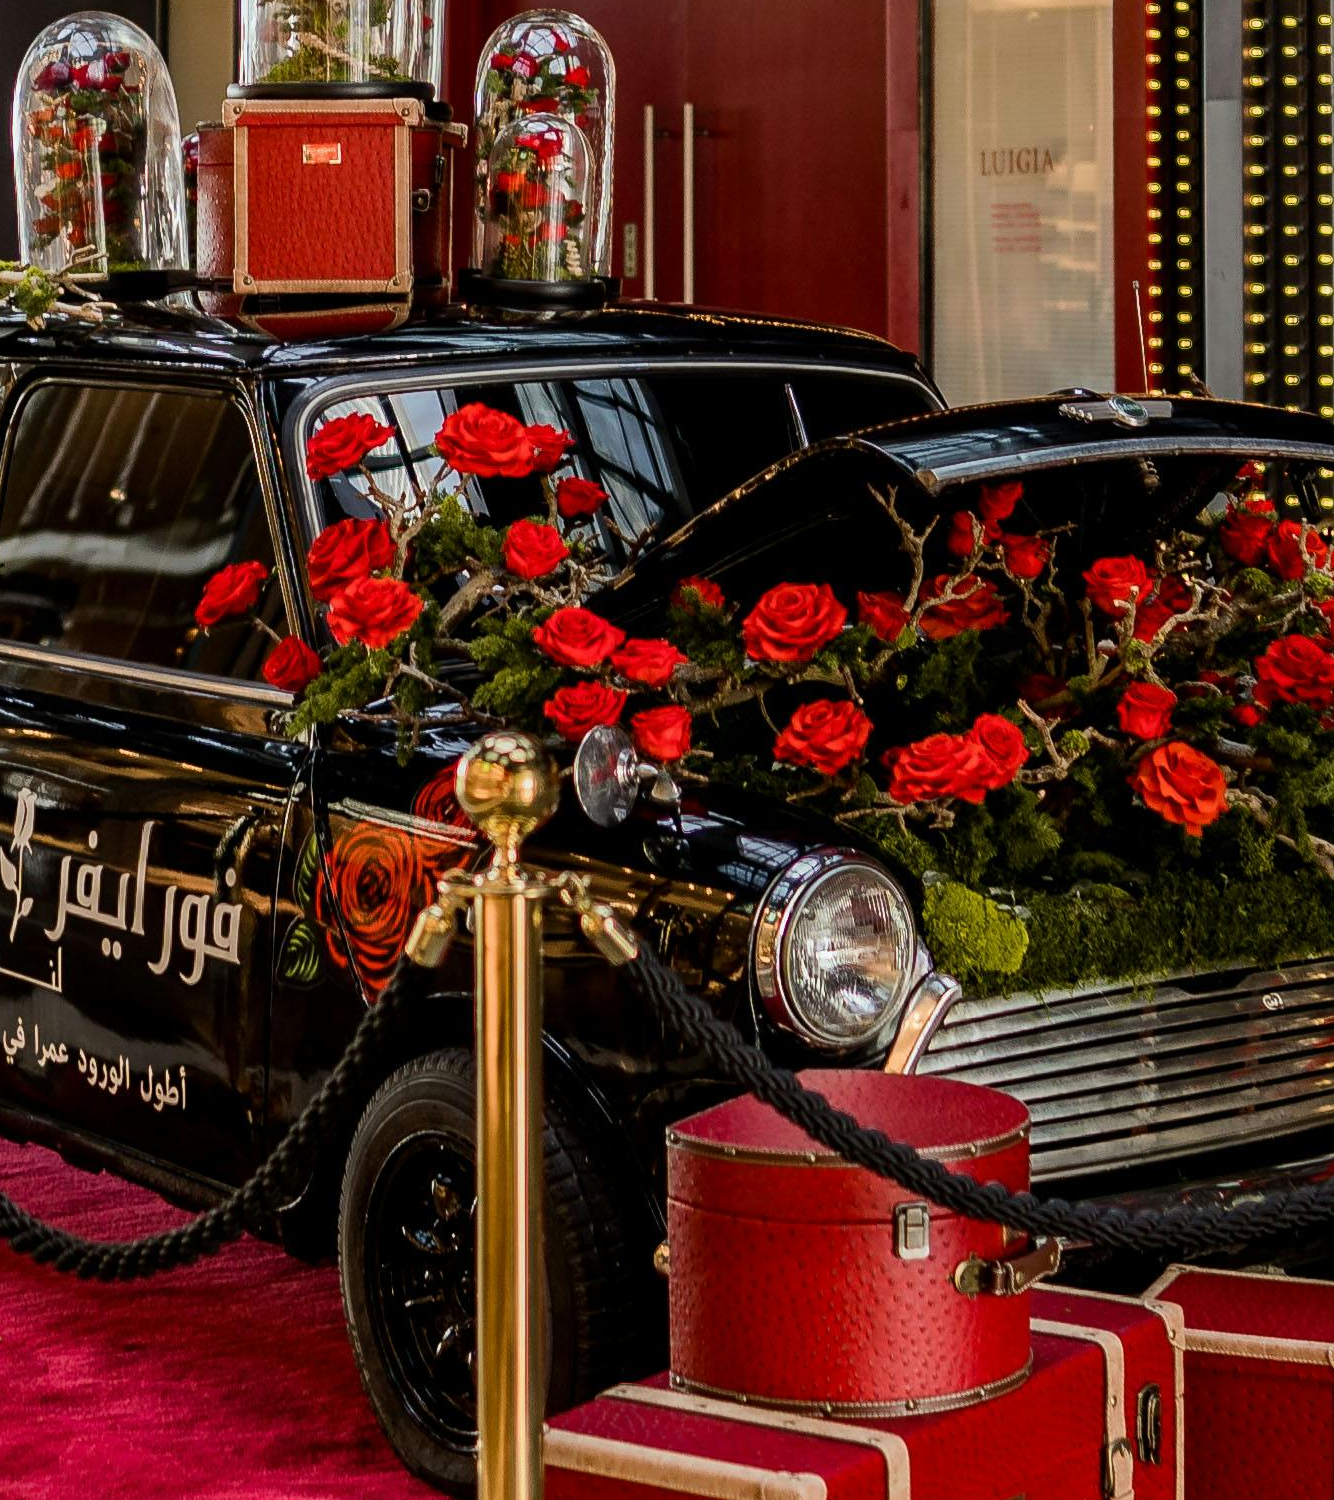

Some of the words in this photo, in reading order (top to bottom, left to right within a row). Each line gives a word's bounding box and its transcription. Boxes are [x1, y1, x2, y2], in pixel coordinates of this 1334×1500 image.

[979, 146, 1056, 177] LUIGIA
[147, 867, 244, 986] فور
[2, 1016, 26, 1064] في
[34, 1023, 69, 1067] عمرا
[77, 1047, 131, 1095] الورود
[140, 1065, 188, 1112] أطول
